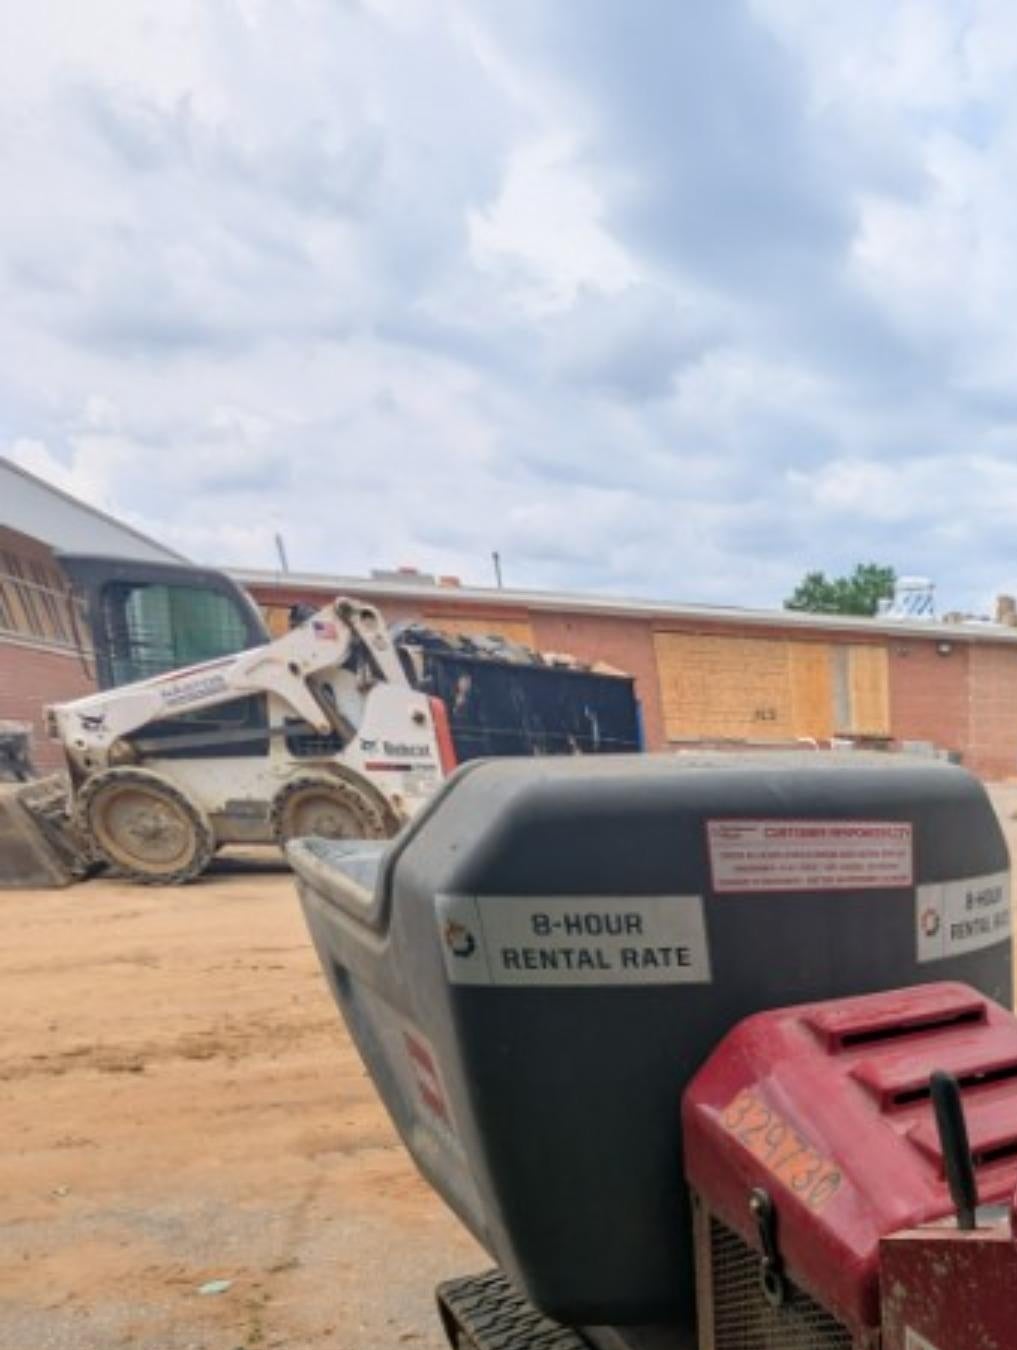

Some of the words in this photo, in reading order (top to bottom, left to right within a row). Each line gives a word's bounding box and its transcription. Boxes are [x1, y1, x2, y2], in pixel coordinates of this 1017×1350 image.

[531, 912, 643, 936] 8-HOUR
[951, 915, 991, 942] RENTAL
[503, 949, 612, 970] RENTAL
[622, 947, 693, 969] RATE
